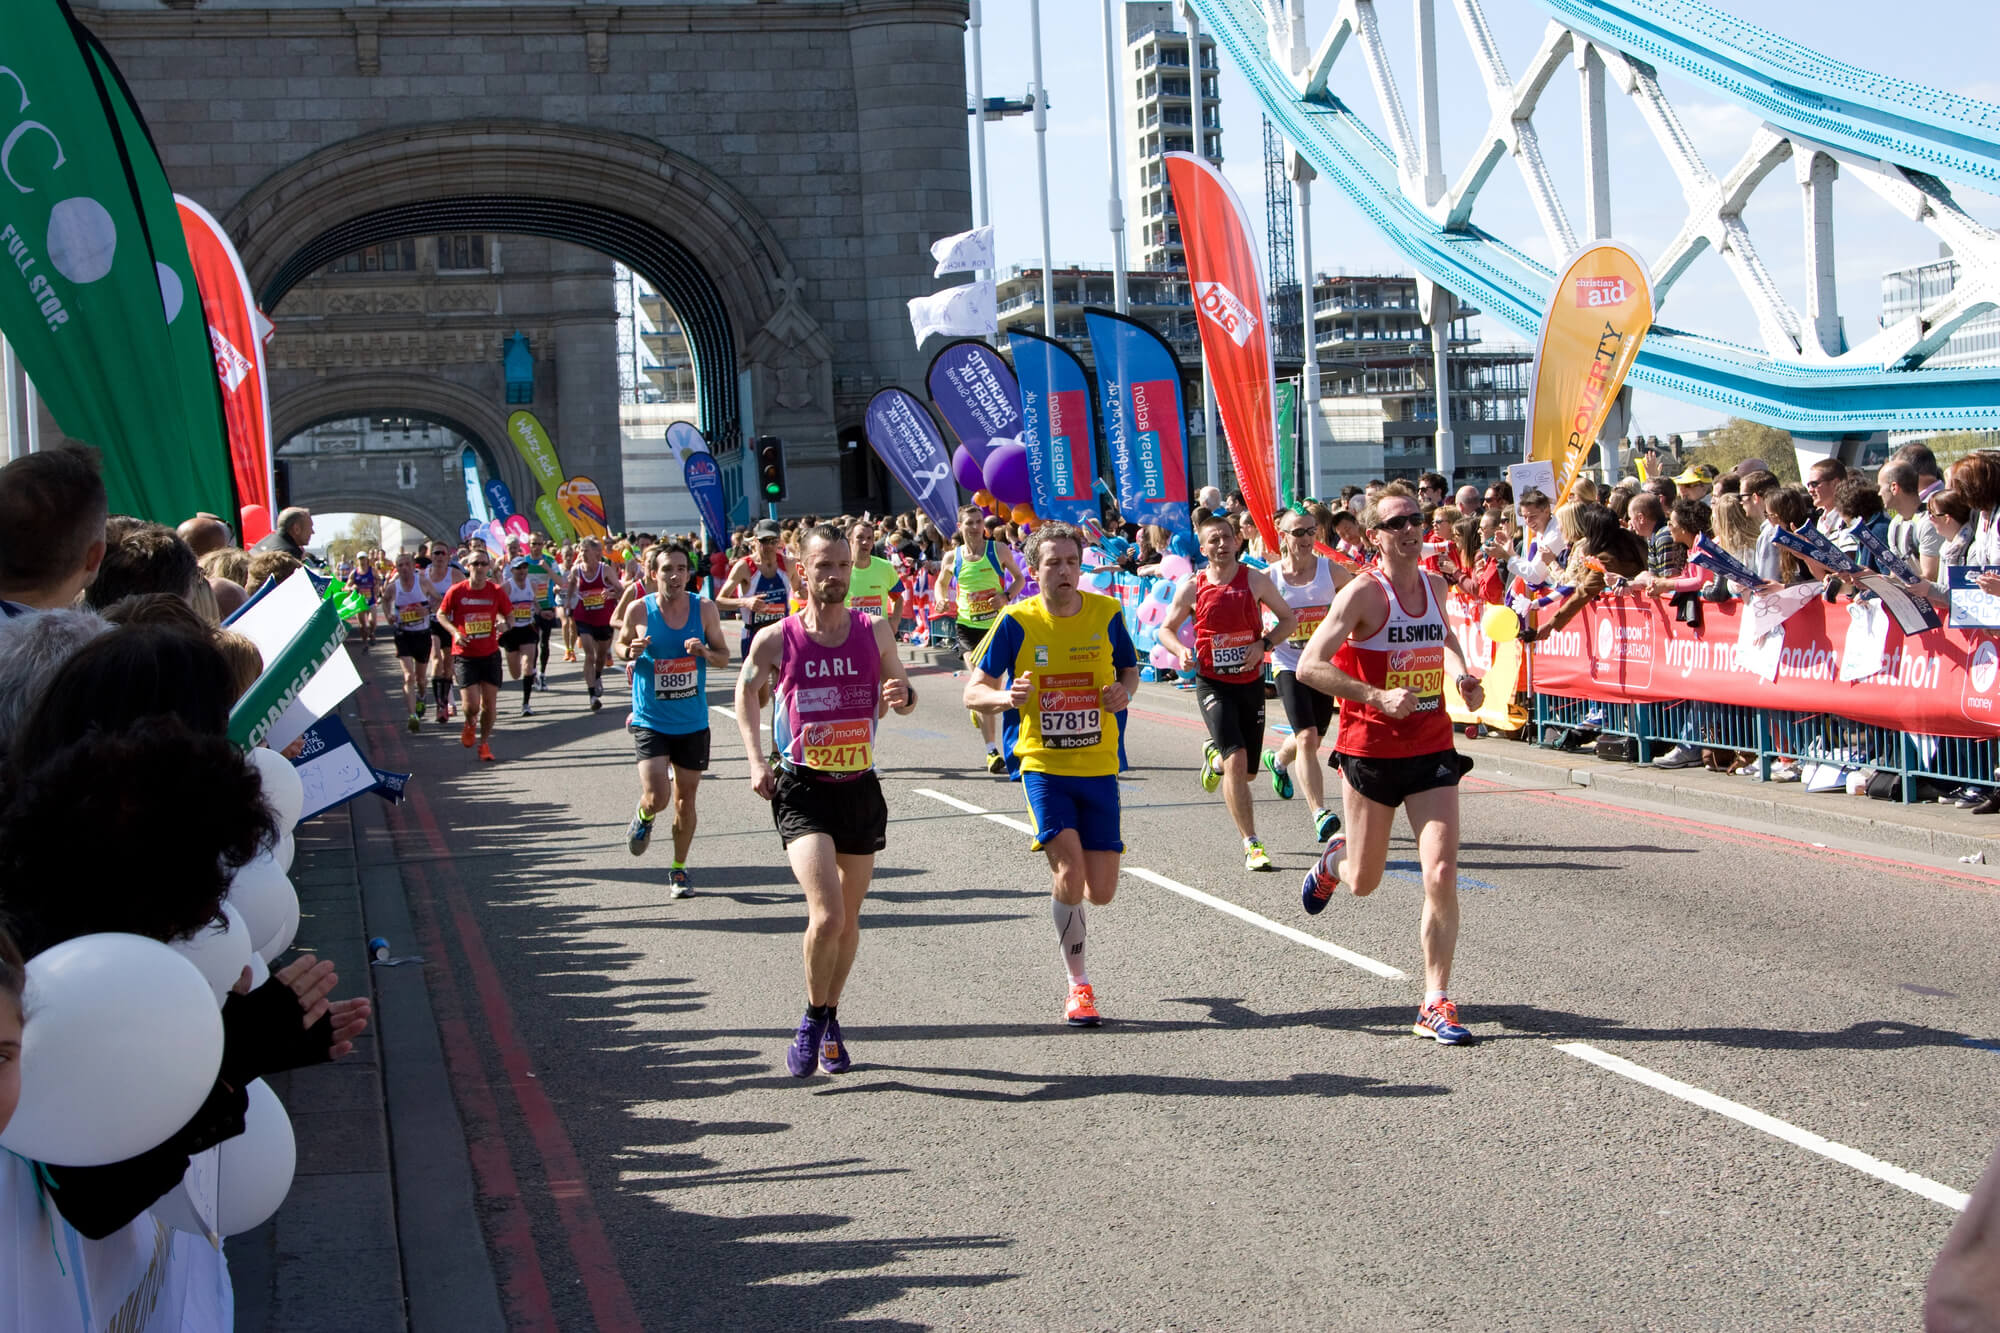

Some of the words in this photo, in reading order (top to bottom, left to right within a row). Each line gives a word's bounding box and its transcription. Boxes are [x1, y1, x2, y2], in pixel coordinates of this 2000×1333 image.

[0, 223, 35, 279] FULL
[29, 274, 69, 333] STOP.
[1575, 277, 1615, 289] christian
[1587, 279, 1628, 308] aid
[1567, 319, 1623, 452] POVERTY
[1387, 623, 1444, 643] ELSWICK
[1614, 626, 1643, 641] LONDON
[1391, 651, 1414, 672] Virgin
[1416, 655, 1443, 665] money
[1614, 643, 1652, 659] MARATHON
[1664, 629, 1709, 679] virgin
[1778, 639, 1837, 681] ondon
[804, 657, 859, 679] CARL
[661, 672, 693, 688] 8891
[1388, 671, 1441, 692] 31930
[1041, 691, 1065, 710] Virgin
[1067, 694, 1098, 704] money
[1967, 696, 1993, 713] money
[1041, 710, 1100, 731] 57819
[808, 725, 834, 746] Virgin
[835, 727, 869, 739] money
[1060, 735, 1100, 748] #boost
[806, 744, 869, 767] 32471
